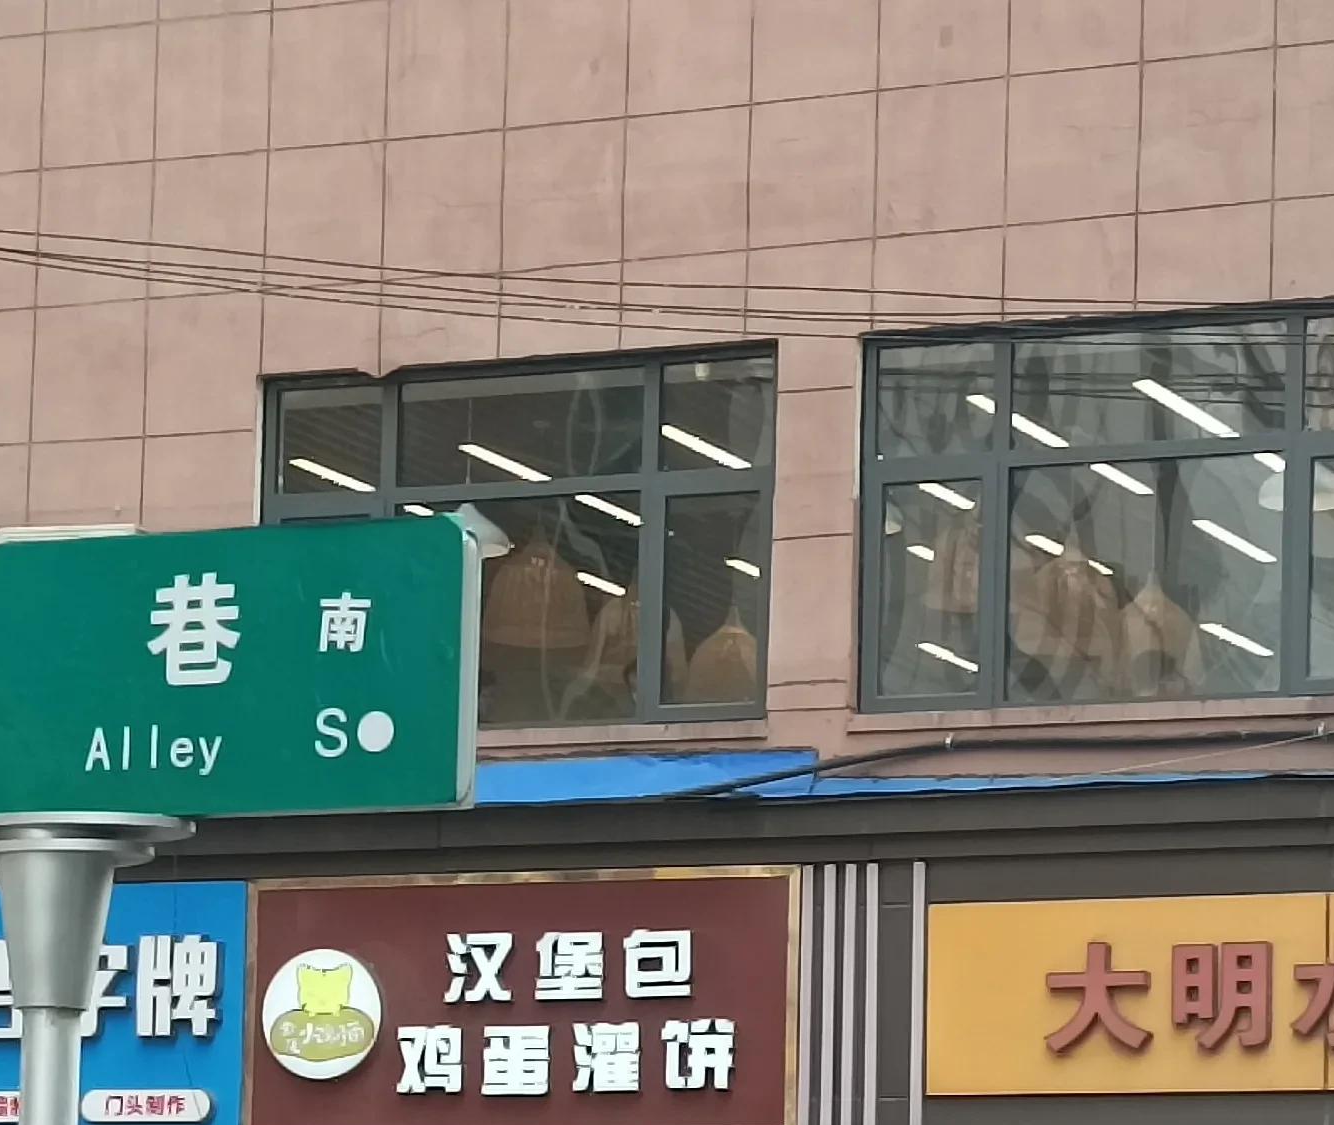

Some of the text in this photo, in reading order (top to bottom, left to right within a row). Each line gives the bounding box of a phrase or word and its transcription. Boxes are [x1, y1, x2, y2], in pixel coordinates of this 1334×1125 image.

[147, 572, 241, 686] 巷
[319, 592, 372, 652] 南
[85, 724, 222, 776] Alley
[315, 707, 348, 758] S
[443, 928, 693, 1003] 汉堡包
[395, 1018, 736, 1096] 鸡蛋灌饼
[103, 1095, 186, 1117] 门头制作
